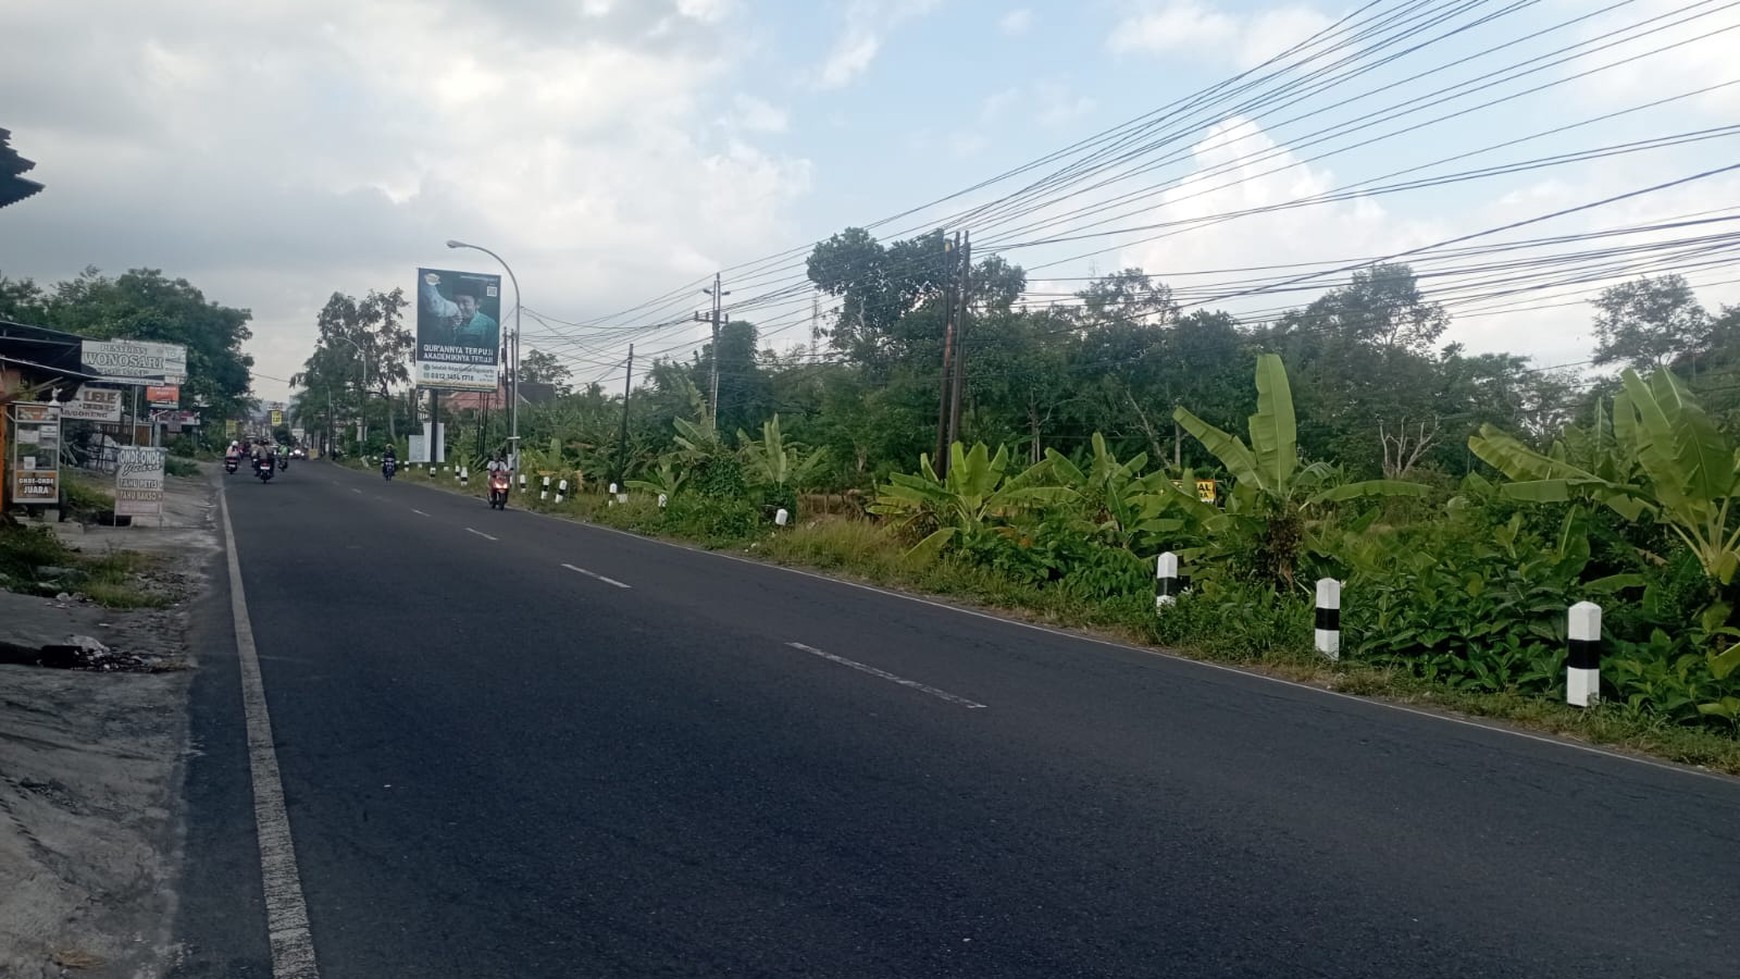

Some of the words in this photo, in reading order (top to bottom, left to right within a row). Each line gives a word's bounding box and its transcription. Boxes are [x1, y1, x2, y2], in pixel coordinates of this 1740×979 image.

[423, 344, 463, 354] QUR'ANNYA
[84, 351, 164, 369] WONOSARI
[24, 485, 49, 494] JUARA
